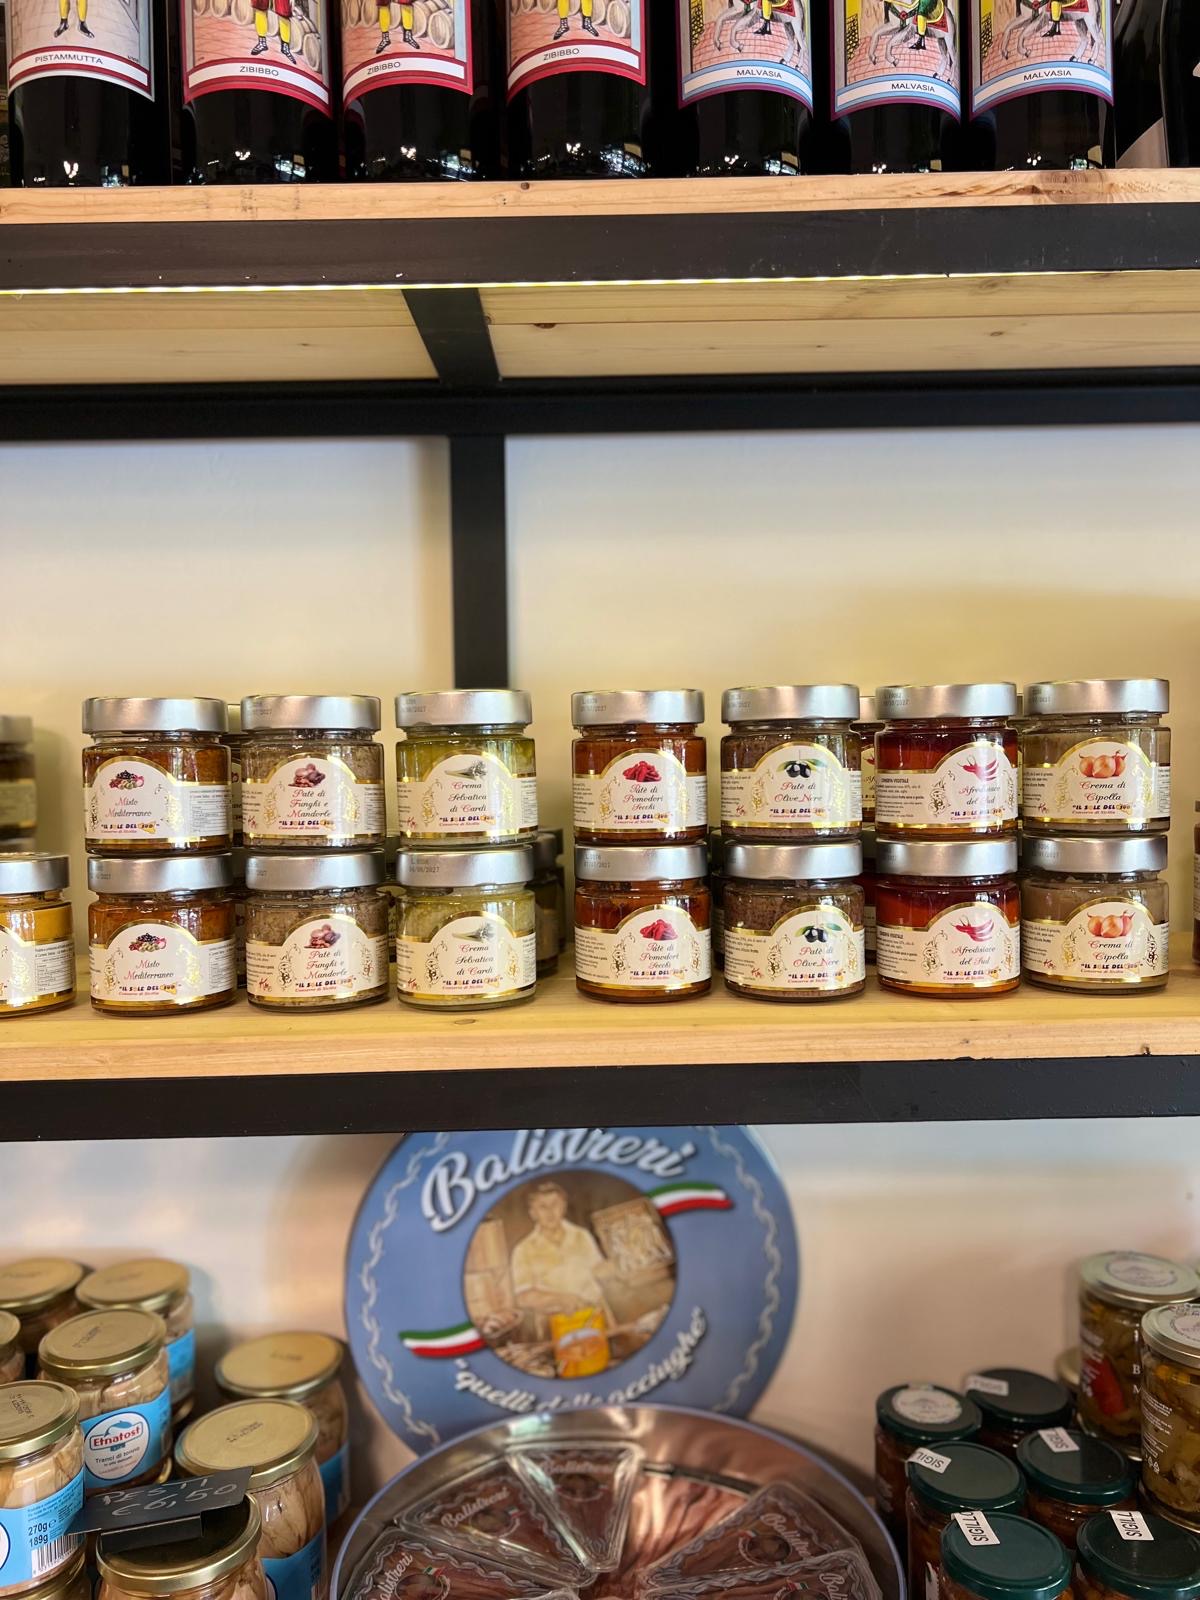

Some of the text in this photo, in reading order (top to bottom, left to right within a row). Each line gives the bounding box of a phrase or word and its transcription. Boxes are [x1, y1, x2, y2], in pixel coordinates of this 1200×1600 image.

[35, 53, 104, 65] PISTAMMUTTA
[543, 47, 580, 62] ZIBIBBO
[239, 64, 279, 77] ZIBIBBO
[366, 61, 402, 75] ZIBIBBO
[736, 69, 782, 79] MALVASIA
[1023, 69, 1072, 81] MALVASIA
[891, 82, 936, 92] MALVASIA
[452, 782, 482, 790] Crema
[808, 782, 816, 790] di
[1080, 781, 1126, 790] Crema di
[115, 797, 138, 806] Misto
[448, 793, 487, 801] Selvatica
[623, 795, 664, 803] Pomodori
[774, 793, 823, 802] Olive Nere
[1085, 792, 1121, 803] Cipolla
[289, 800, 320, 809] Funghi
[450, 804, 487, 813] di Cardi
[632, 803, 655, 811] Secchi
[105, 808, 152, 817] Mediterraneo
[287, 810, 331, 818] Mandorle
[459, 944, 489, 953] Crema
[1088, 940, 1133, 949] Crema di
[952, 946, 996, 956] Afrodisiaco
[455, 956, 494, 965] Selvatica
[640, 952, 680, 961] Pomodori
[960, 956, 991, 965] del Sud
[1093, 951, 1129, 962] Cipolla
[136, 959, 160, 969] Misto
[306, 960, 337, 970] Funghi
[648, 961, 671, 970] Secchi
[792, 959, 817, 967] Olive
[123, 969, 174, 980] Mediterraneo
[304, 970, 348, 979] Mandorle
[456, 967, 493, 976] di Cardi
[421, 1128, 696, 1232] Balistreri
[93, 1426, 140, 1447] Etnatost
[95, 1446, 140, 1464] Tranci di tonno
[28, 1522, 48, 1536] 270g
[29, 1534, 49, 1548] 189g
